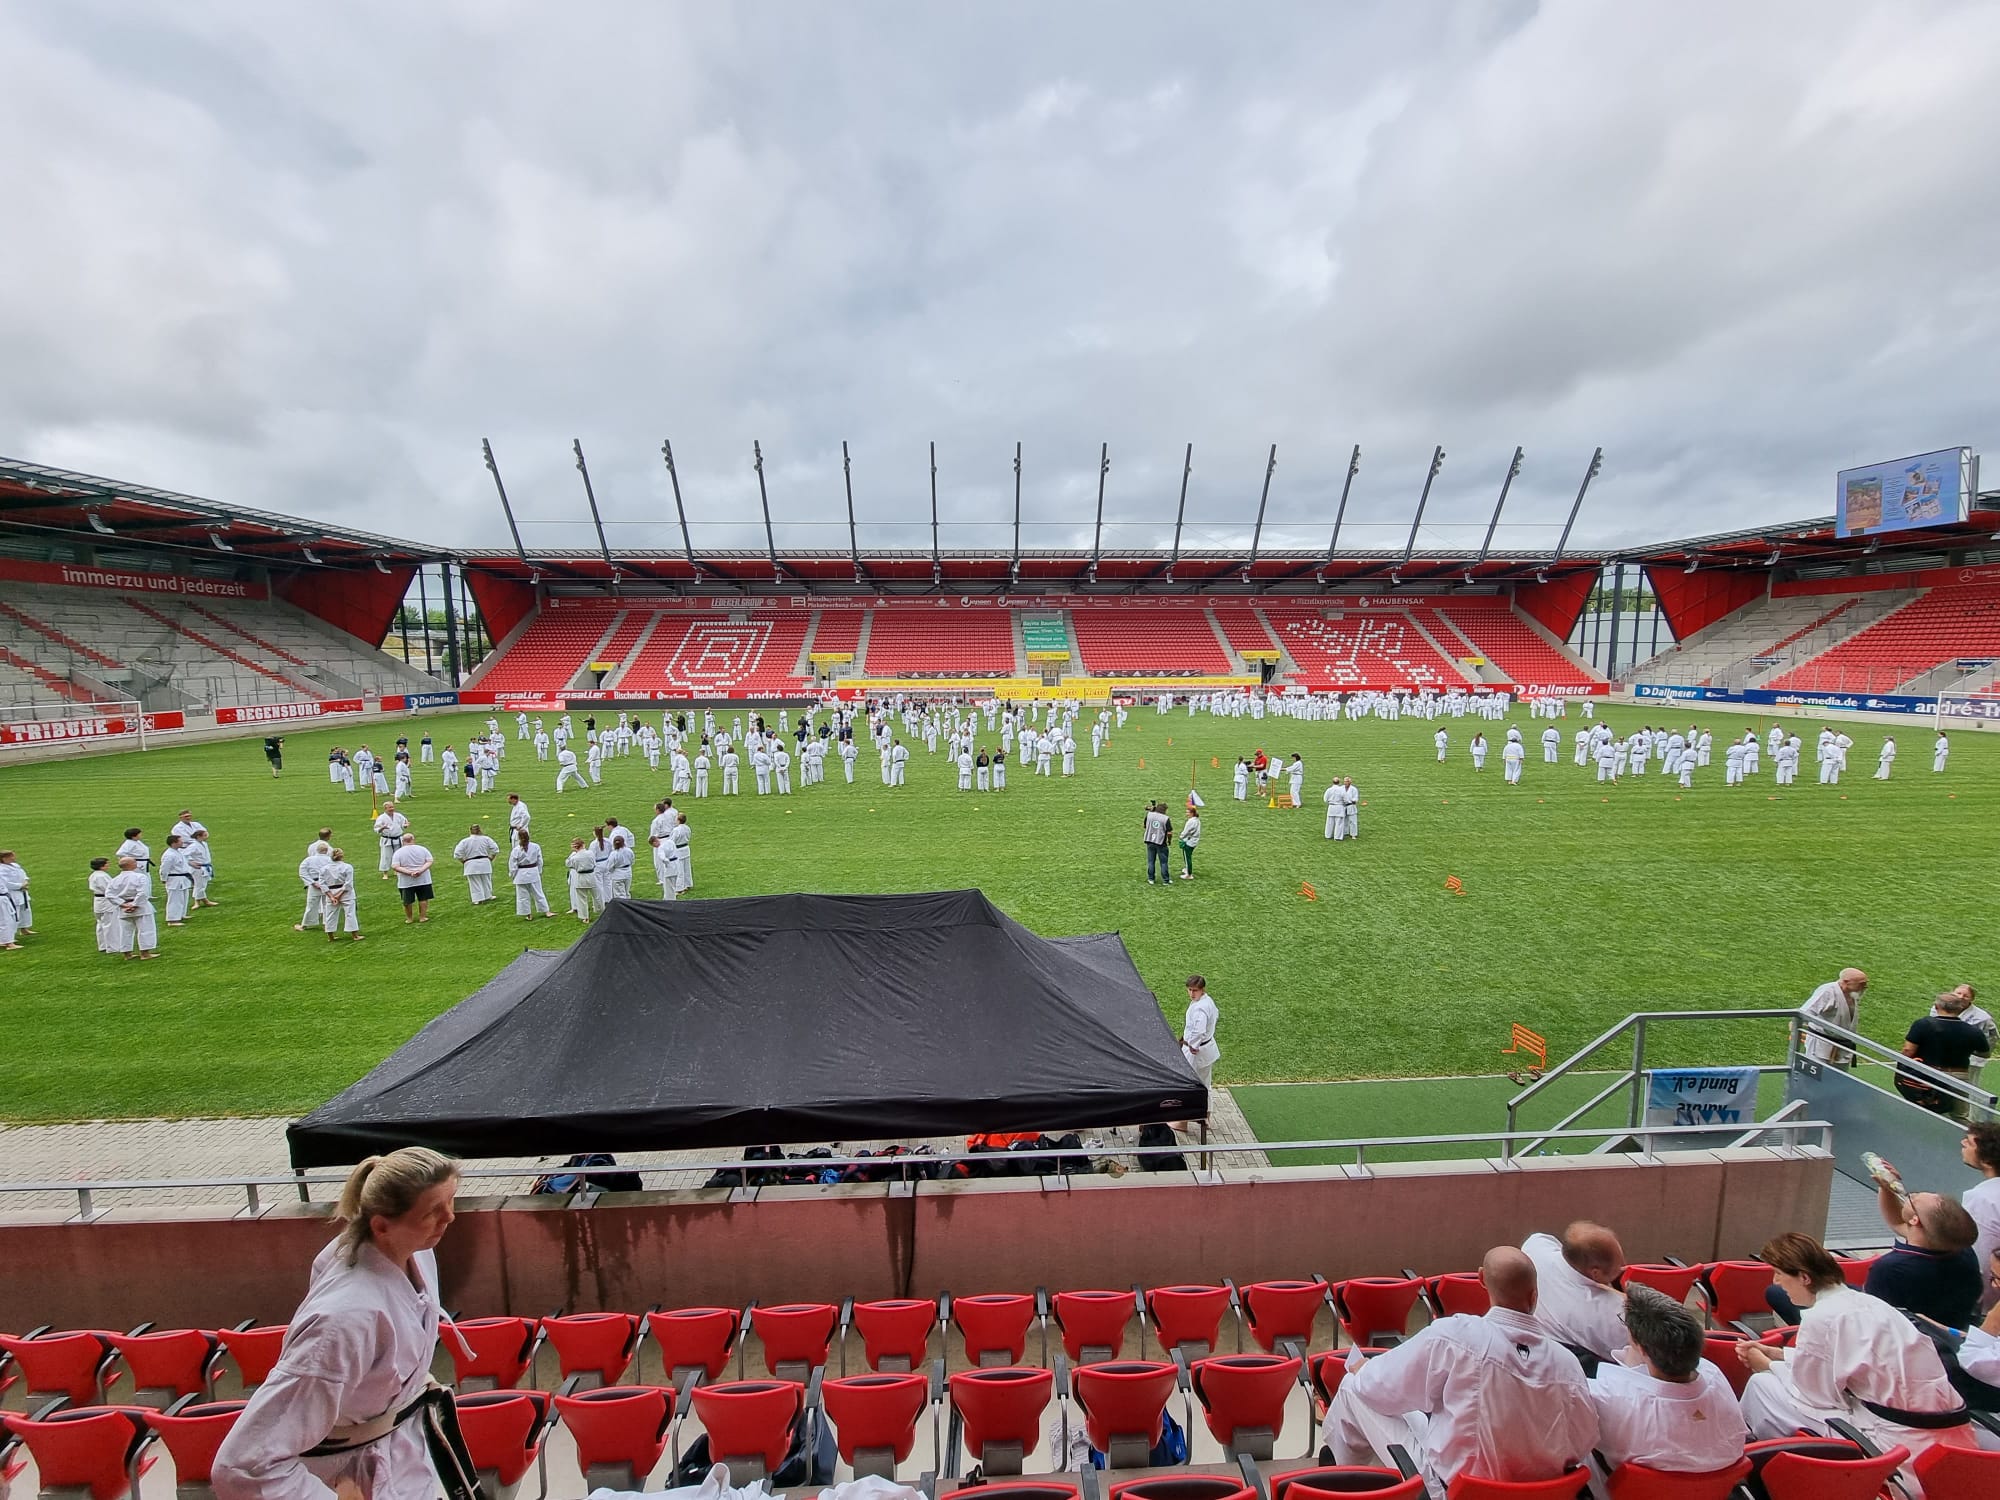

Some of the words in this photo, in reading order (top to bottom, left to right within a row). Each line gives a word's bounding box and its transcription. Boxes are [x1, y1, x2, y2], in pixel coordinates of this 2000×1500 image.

[63, 566, 144, 588] immerzu
[148, 576, 177, 592] und
[181, 579, 246, 597] jederzeit
[746, 690, 782, 700] andré
[786, 690, 817, 700] media
[1026, 688, 1049, 697] Netto
[1056, 688, 1078, 697] Netto
[1085, 687, 1106, 696] Netto
[1527, 684, 1592, 695] Dallmeier
[1651, 688, 1697, 698] Dallmeier
[419, 696, 454, 706] Dallmeier
[1775, 694, 1857, 707] andre-media.de
[236, 703, 320, 721] REGENSBURG
[1799, 1061, 1806, 1069] T
[1809, 1066, 1817, 1074] 5
[1672, 1076, 1696, 1093] e.V.
[1698, 1077, 1738, 1095] Bund
